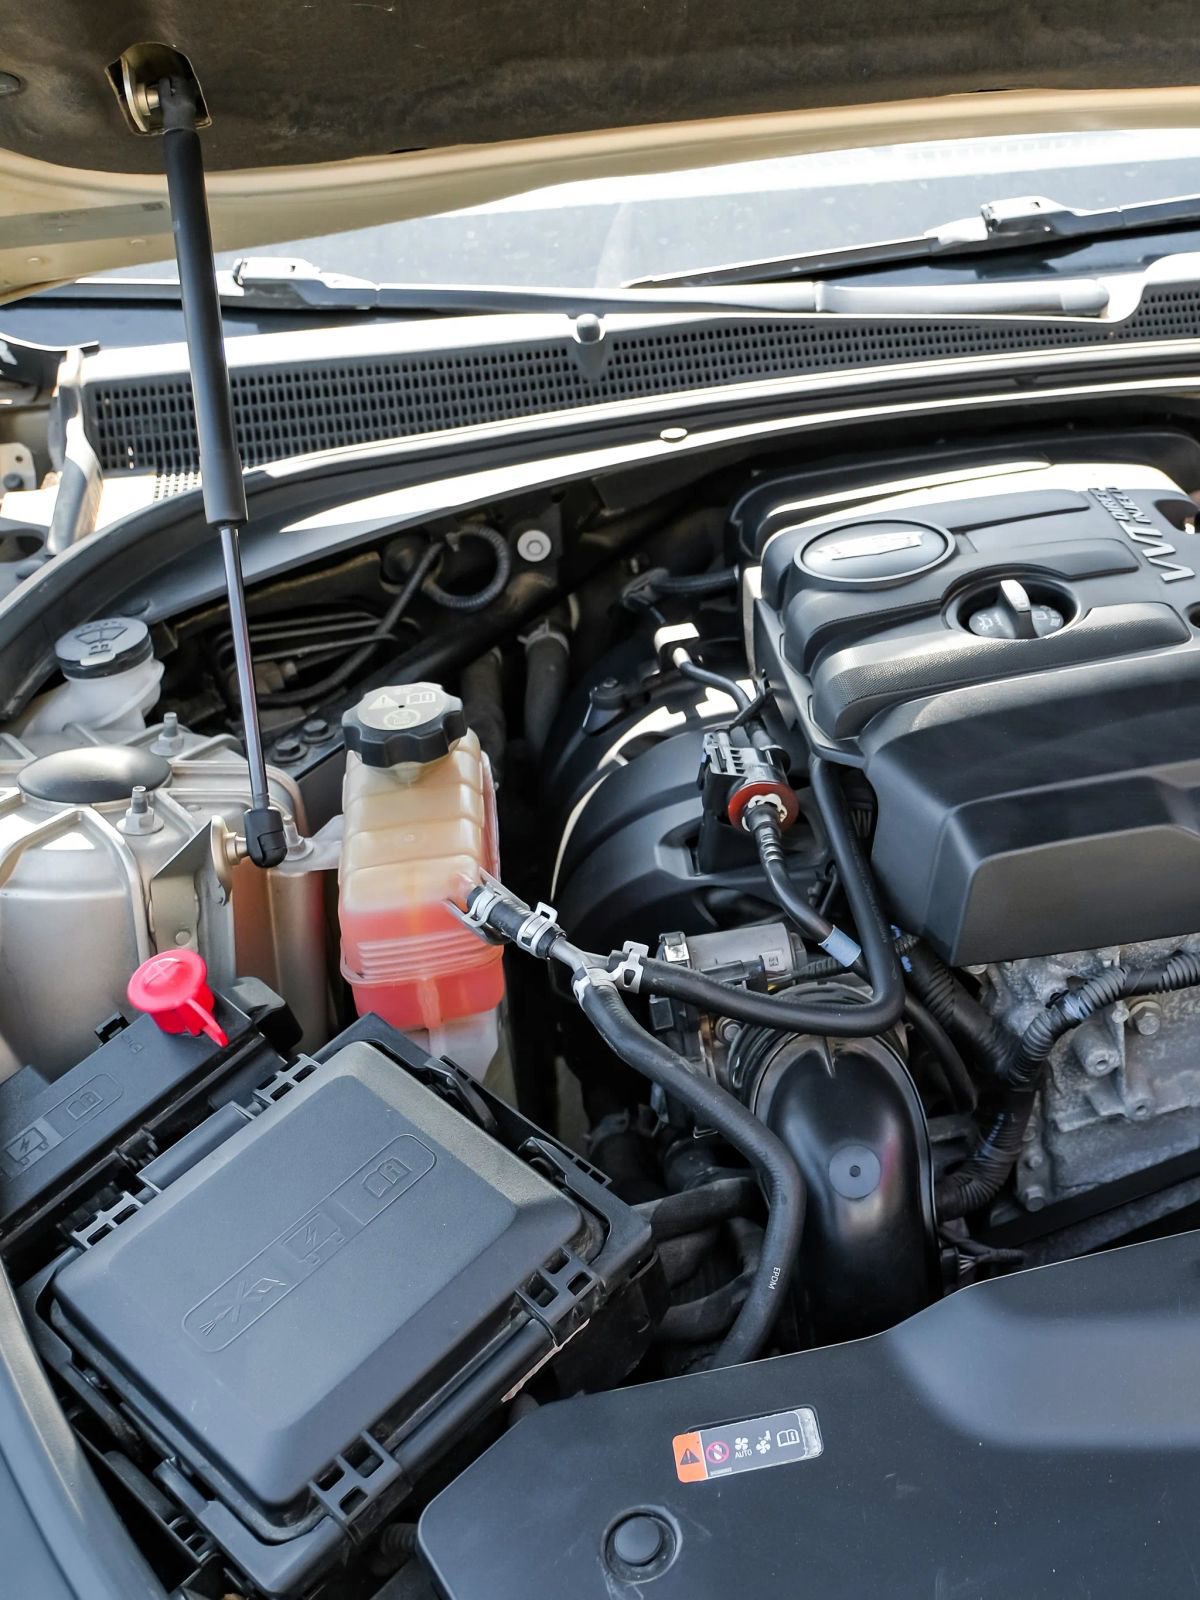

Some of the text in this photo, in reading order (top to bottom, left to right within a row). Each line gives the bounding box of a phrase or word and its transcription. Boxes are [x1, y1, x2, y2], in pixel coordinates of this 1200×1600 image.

[1118, 520, 1195, 583] VVT
[768, 1267, 780, 1290] EPDM
[735, 1449, 753, 1459] AUTO
